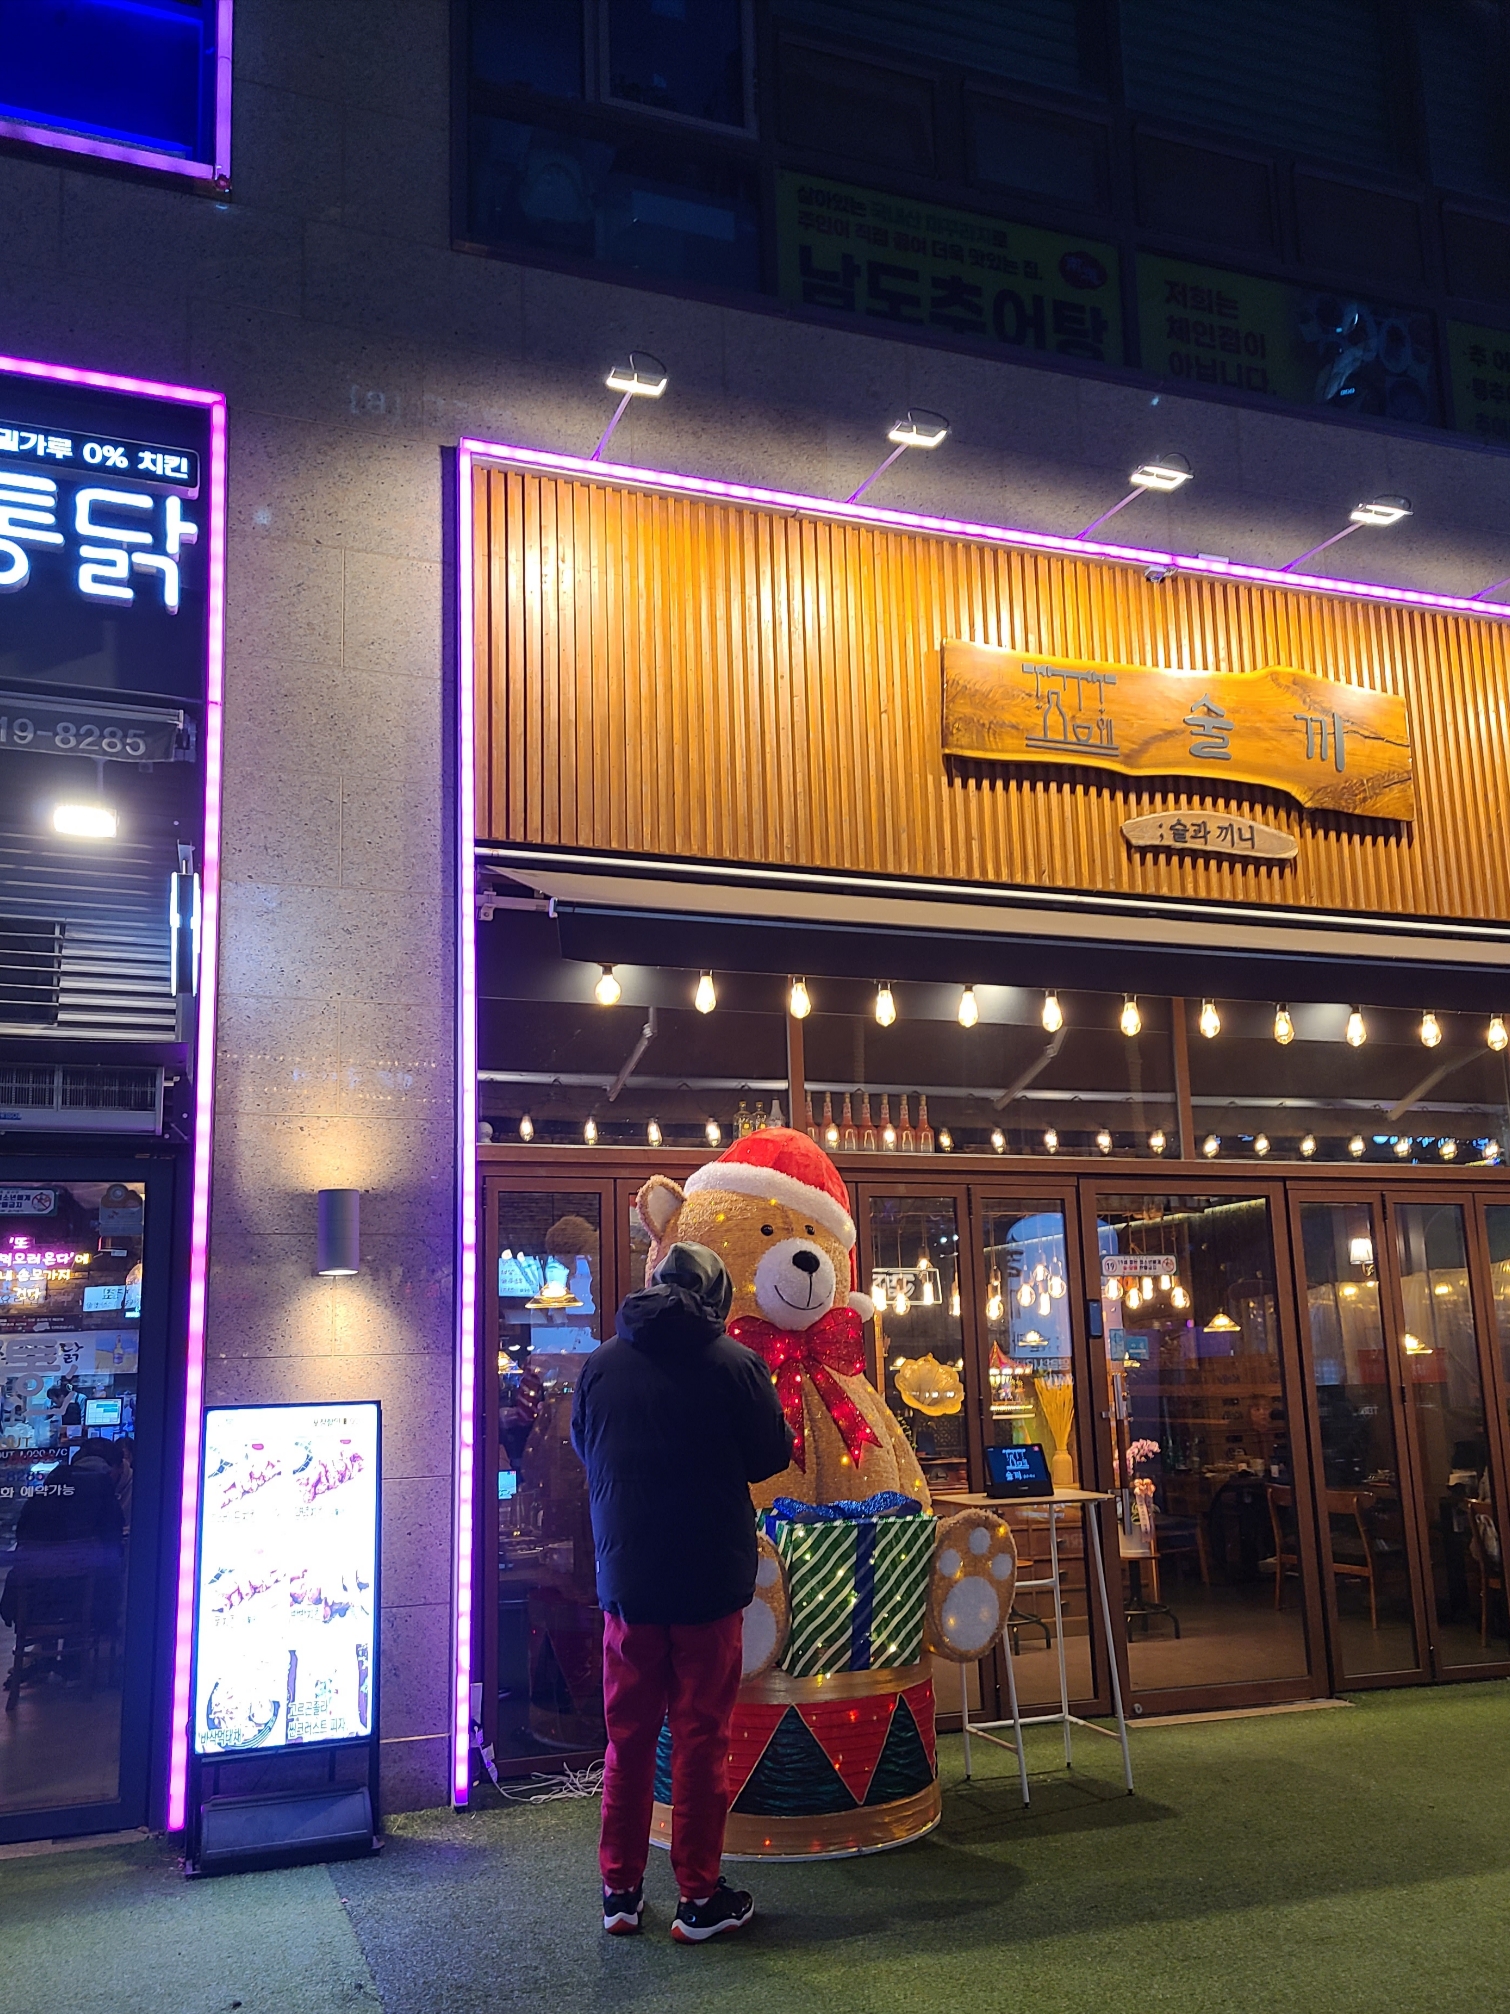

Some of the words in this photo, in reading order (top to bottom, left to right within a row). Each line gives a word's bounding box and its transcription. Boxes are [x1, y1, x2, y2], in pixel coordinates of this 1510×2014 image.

[798, 210, 850, 239] 주인이
[798, 244, 1108, 363] 남도추어탕
[1163, 279, 1240, 321] 저희는
[1165, 313, 1267, 361] 체인점이
[1169, 350, 1278, 397] 아닙니다.
[83, 441, 129, 469] 0%
[138, 451, 190, 479] 치킨
[1216, 821, 1256, 850] 끼니
[20, 1483, 76, 1498] 예약가능
